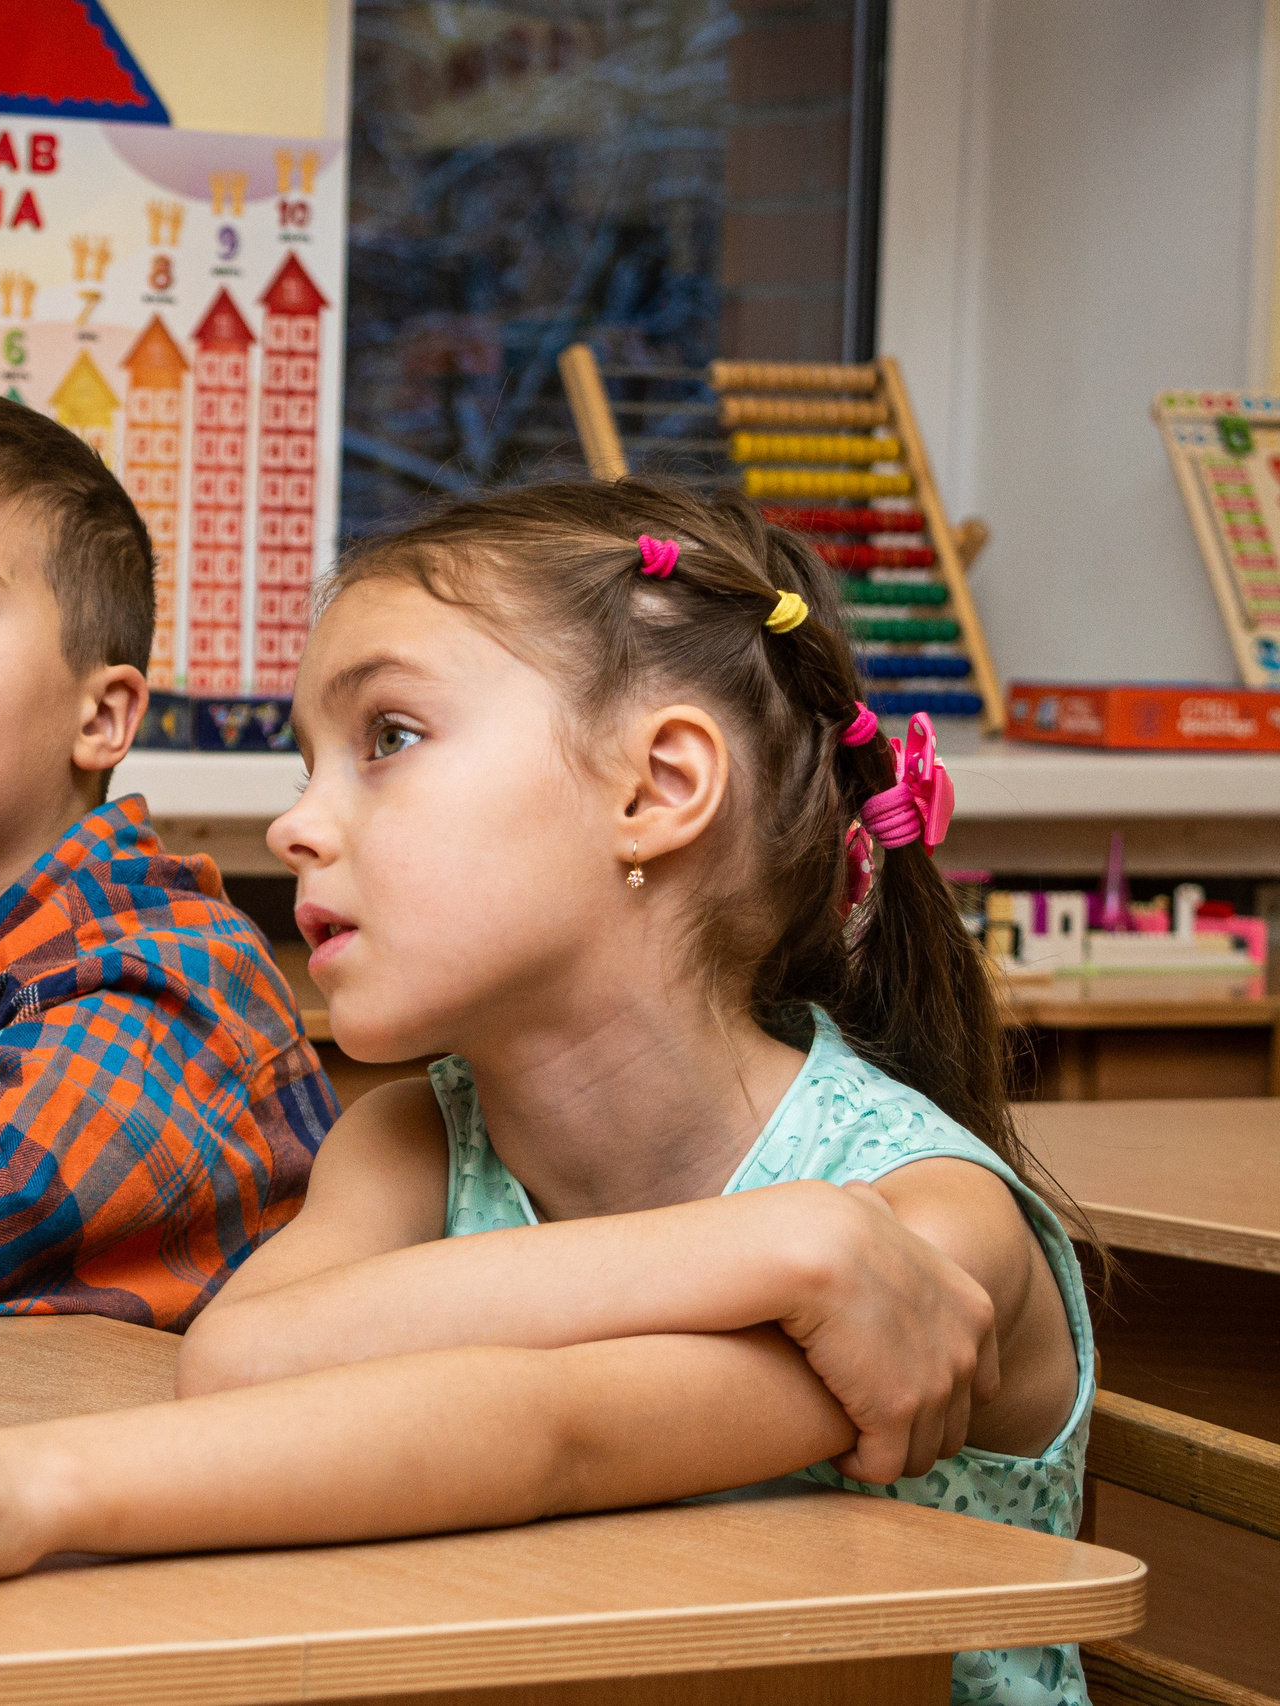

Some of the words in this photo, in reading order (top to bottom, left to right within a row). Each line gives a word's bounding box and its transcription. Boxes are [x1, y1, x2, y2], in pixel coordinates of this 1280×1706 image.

[278, 199, 310, 228] 10
[218, 223, 240, 260] 9
[149, 255, 173, 290] 8
[76, 289, 102, 326] 7
[3, 328, 26, 366] 6
